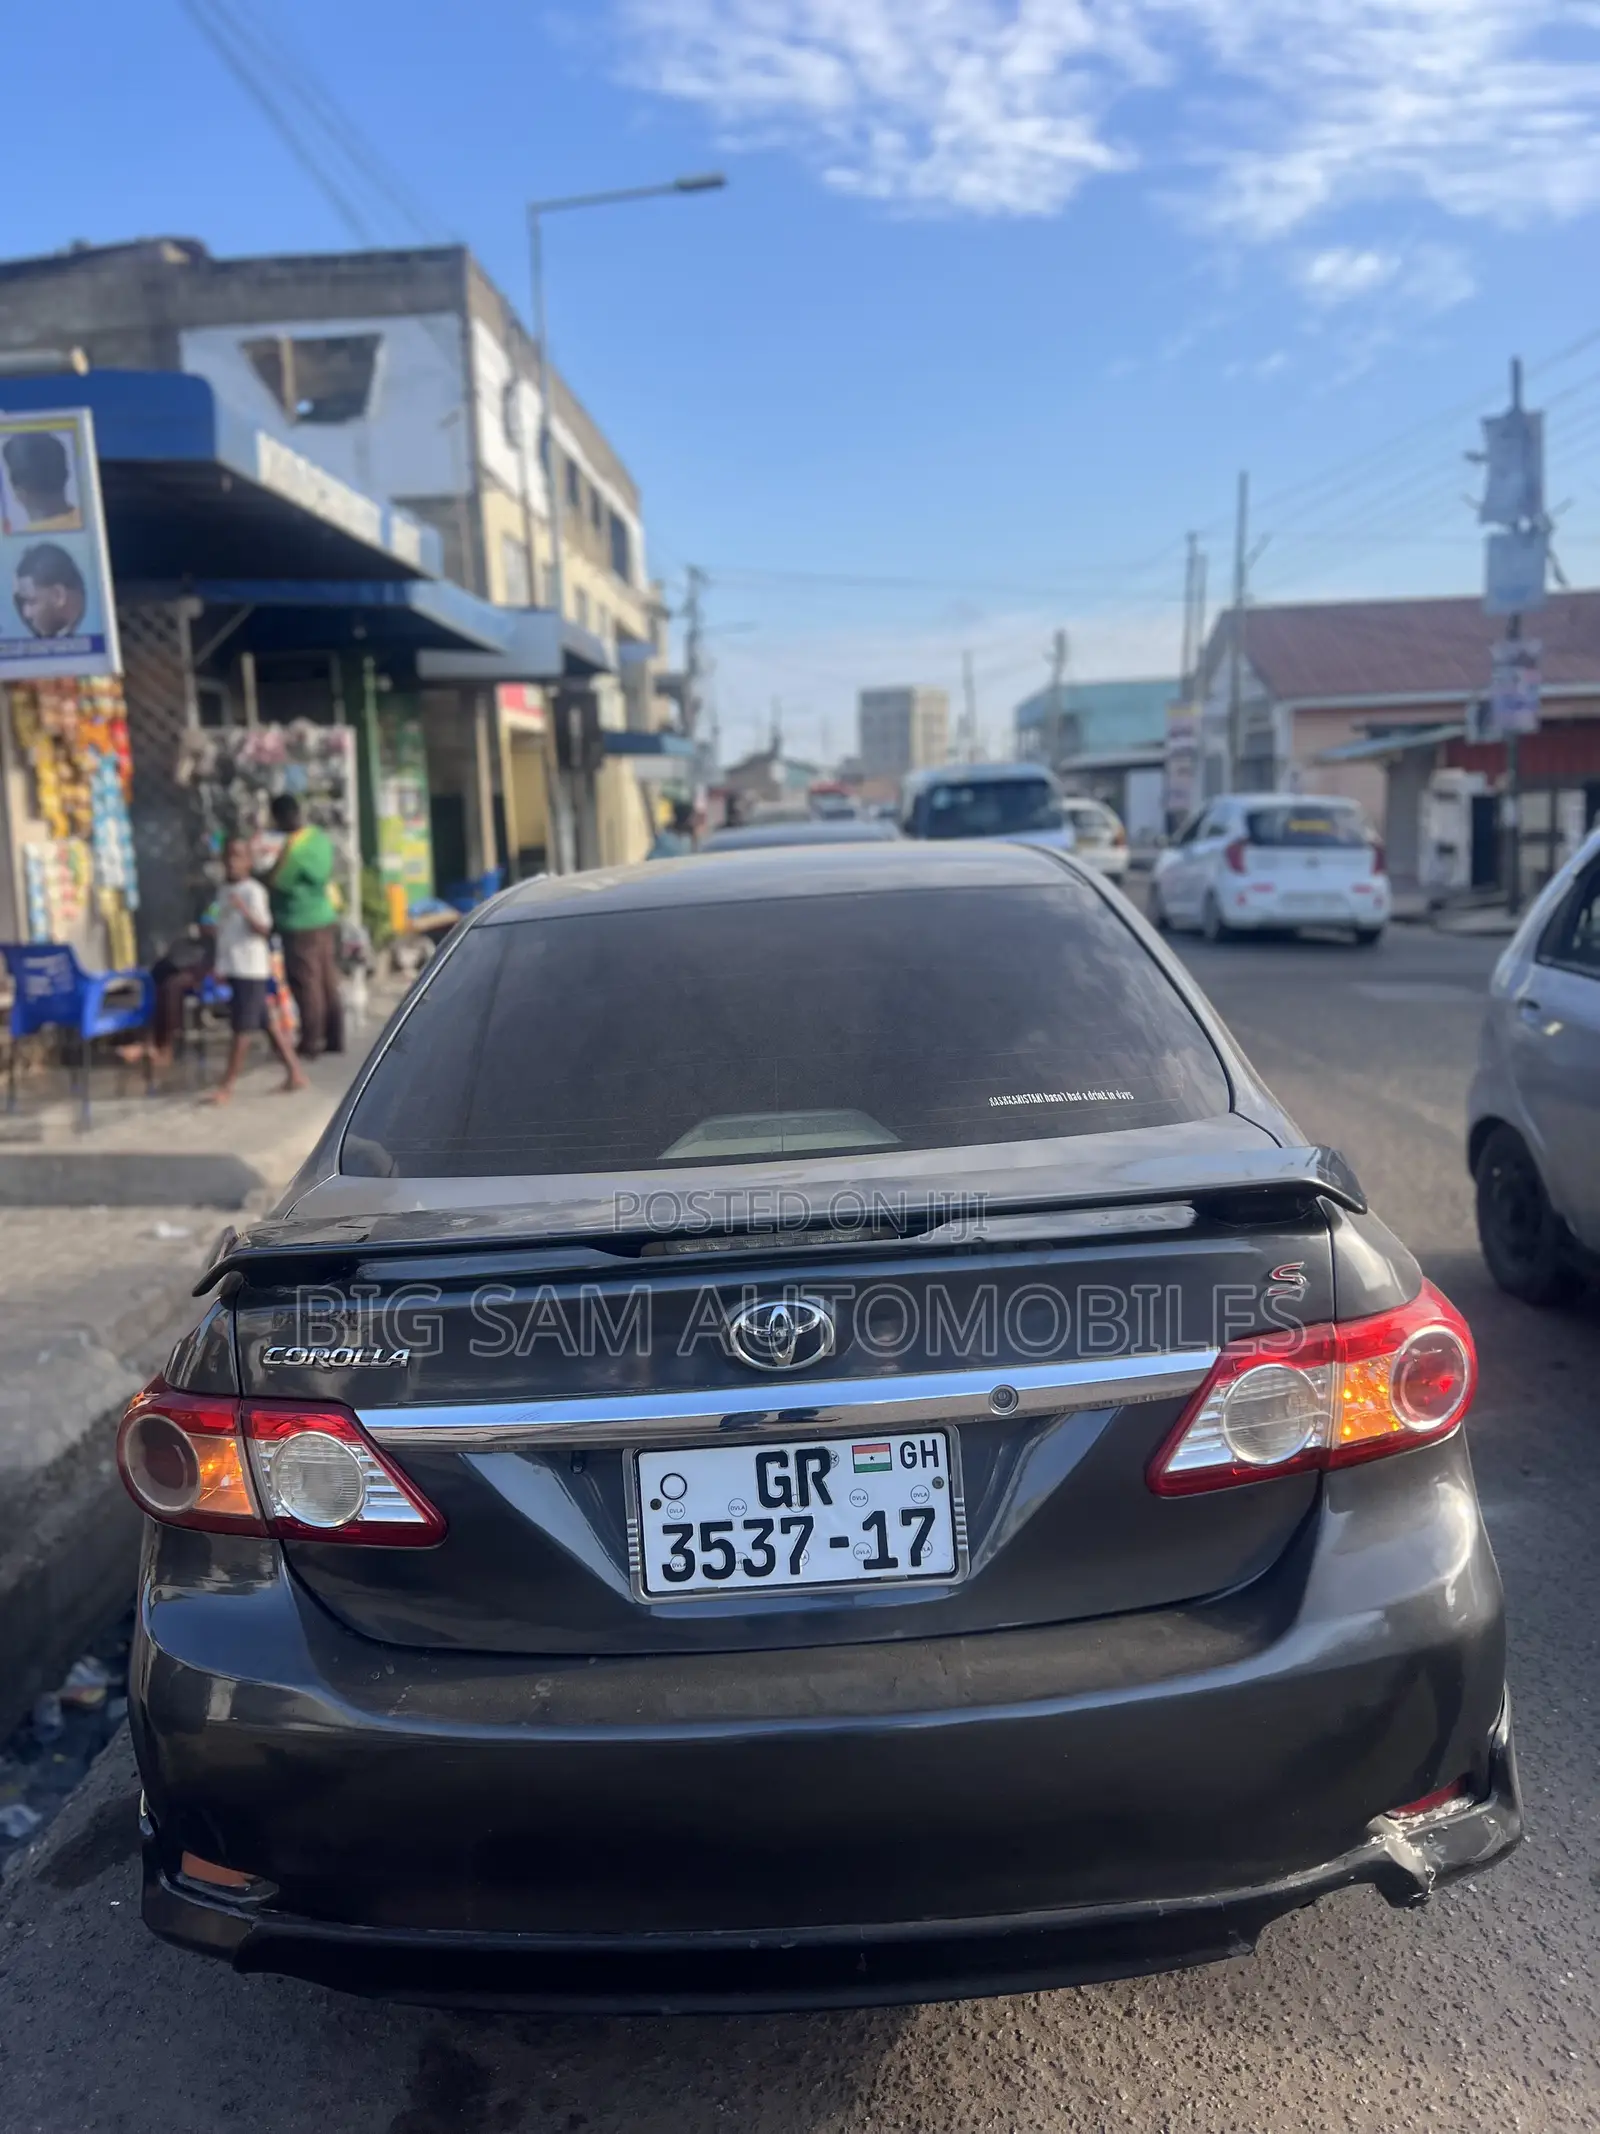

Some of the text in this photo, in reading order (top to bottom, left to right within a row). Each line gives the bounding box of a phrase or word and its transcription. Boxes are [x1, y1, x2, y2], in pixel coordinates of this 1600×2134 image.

[1066, 1091, 1082, 1102] had
[1088, 1090, 1108, 1101] drink
[1107, 1089, 1116, 1100] in
[1116, 1089, 1134, 1100] days
[262, 1346, 410, 1368] COROLLA
[900, 1439, 939, 1469] GH
[755, 1449, 833, 1509] GR
[662, 1507, 936, 1582] 3537-17
